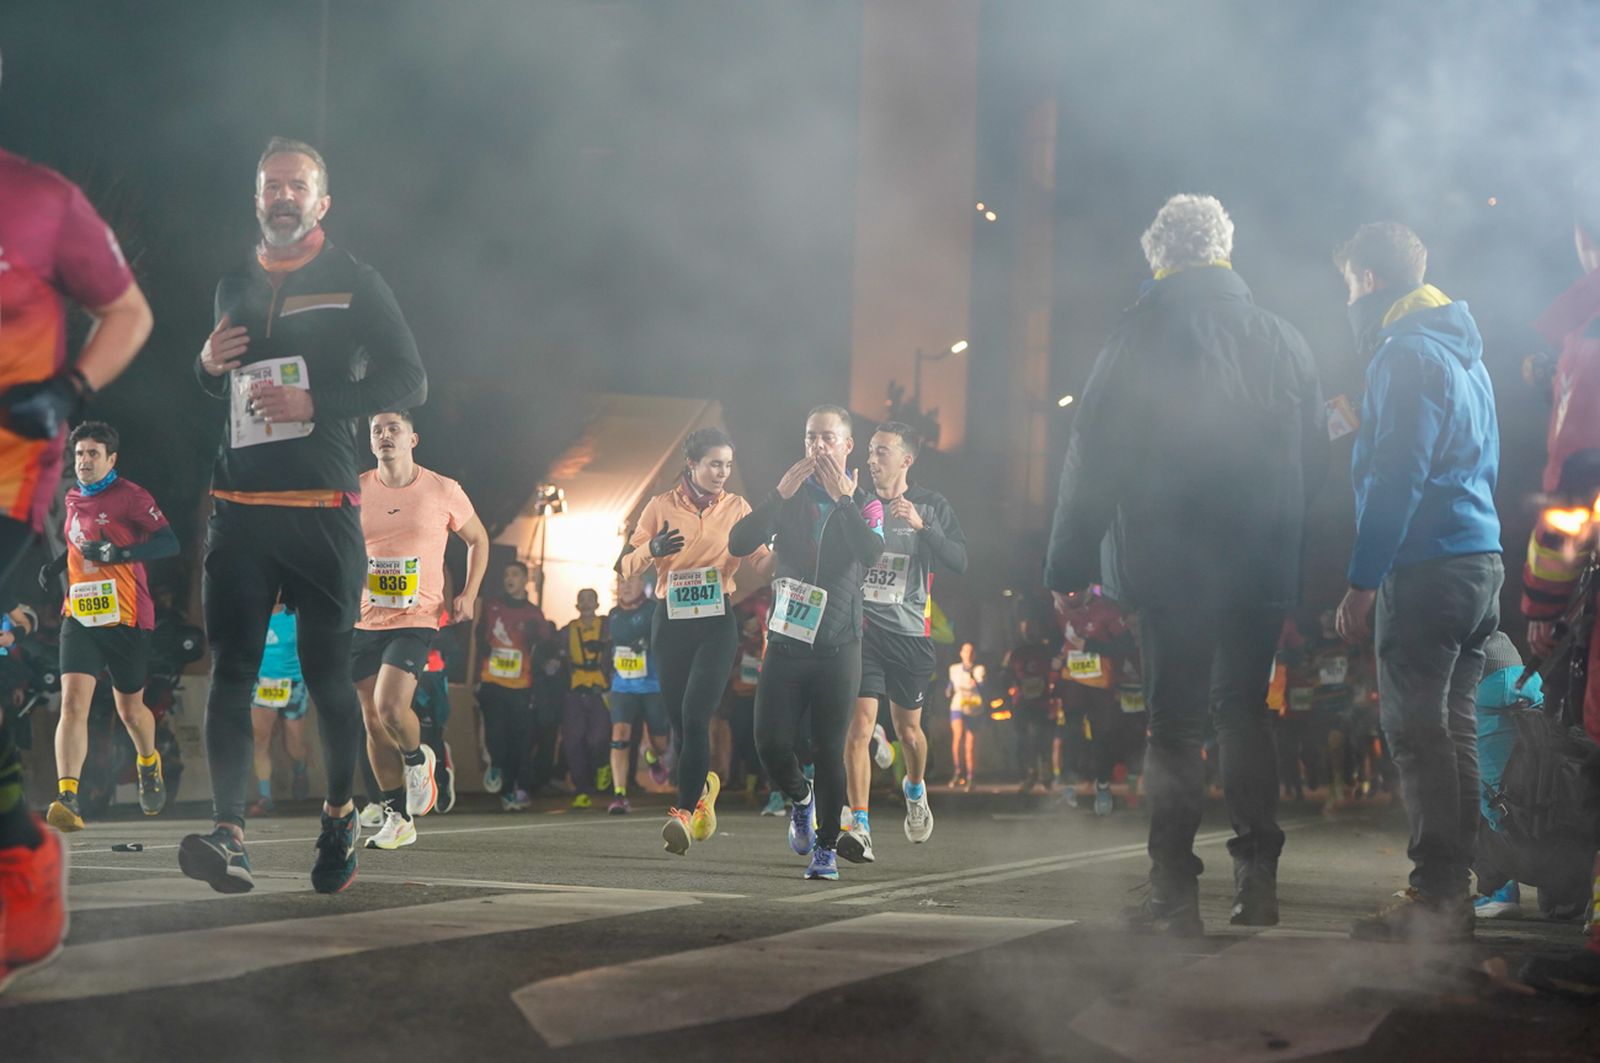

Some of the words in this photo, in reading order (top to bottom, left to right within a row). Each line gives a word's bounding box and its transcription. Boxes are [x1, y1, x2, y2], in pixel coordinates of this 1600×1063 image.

[262, 367, 272, 378] DE
[379, 575, 407, 591] 836
[674, 583, 715, 602] 12847
[78, 596, 110, 612] 6898
